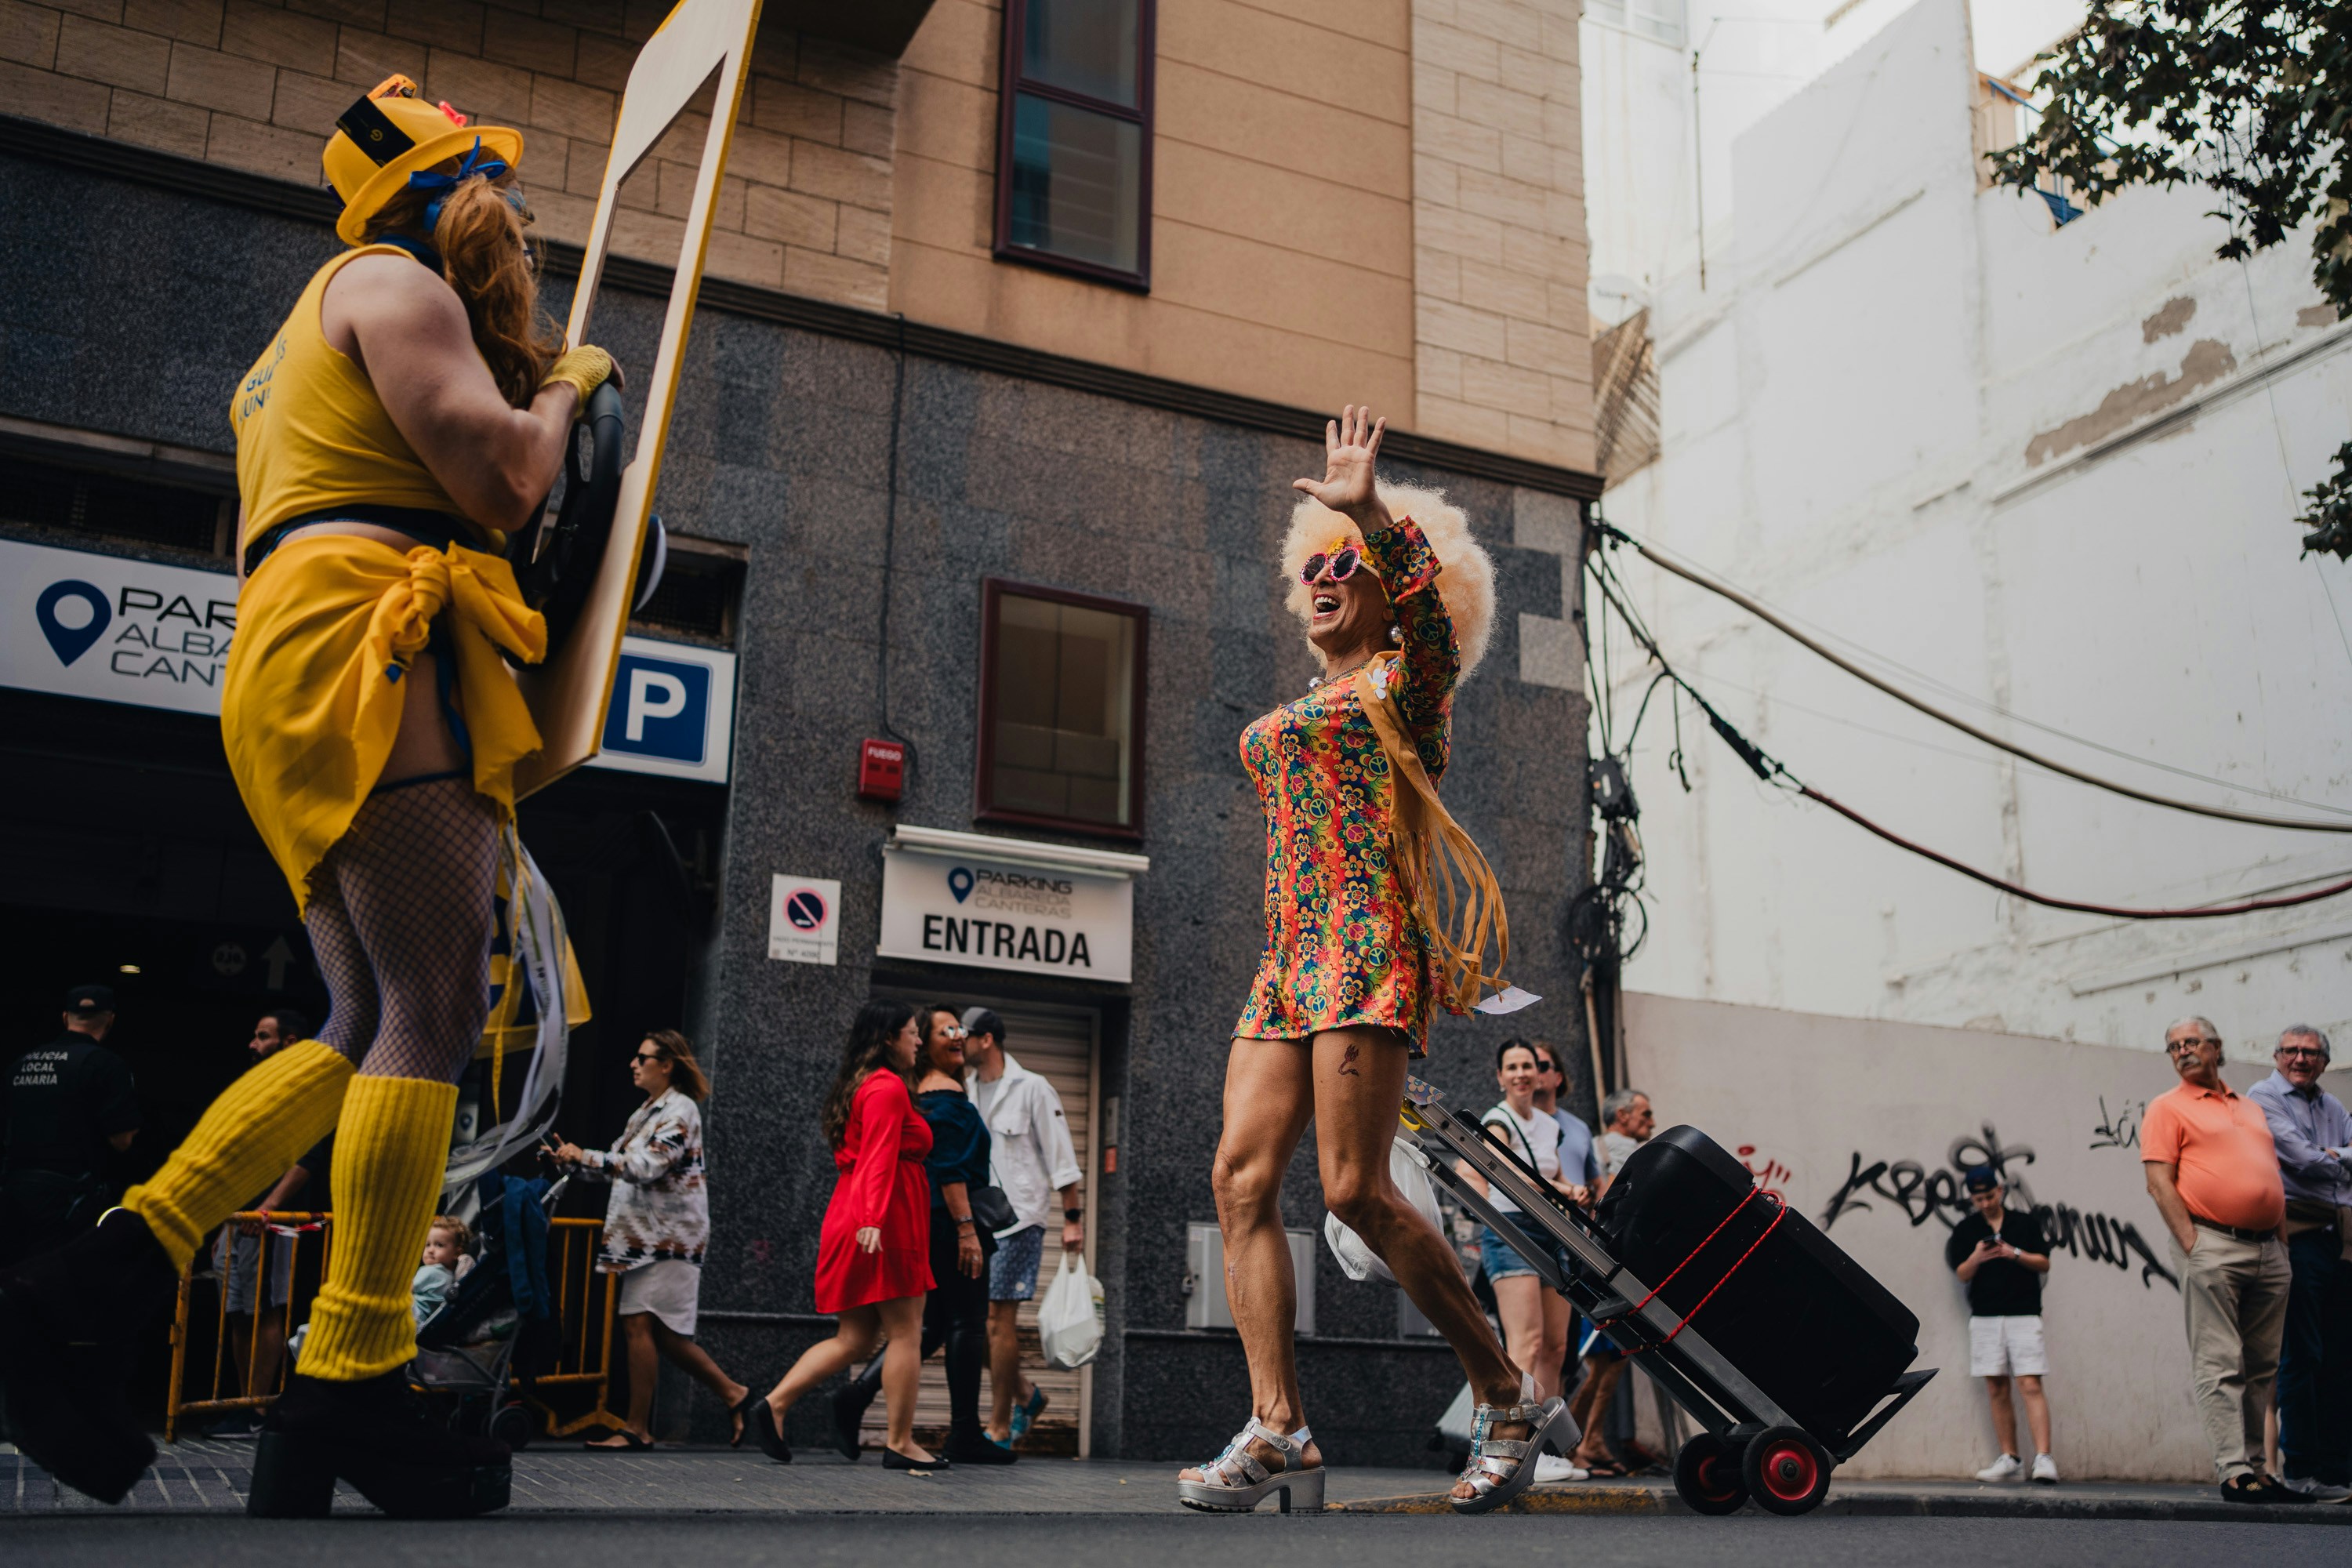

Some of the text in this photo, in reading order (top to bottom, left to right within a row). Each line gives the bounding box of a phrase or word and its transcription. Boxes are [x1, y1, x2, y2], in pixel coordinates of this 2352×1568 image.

[625, 667, 687, 742] P
[867, 746, 902, 762] FUEGO
[975, 869, 1073, 895] PARKING
[975, 895, 1072, 920] CANTERAS
[922, 913, 1092, 968] ENTRADA
[13, 1073, 58, 1087] CANARIA
[21, 1062, 56, 1073] LOCAL
